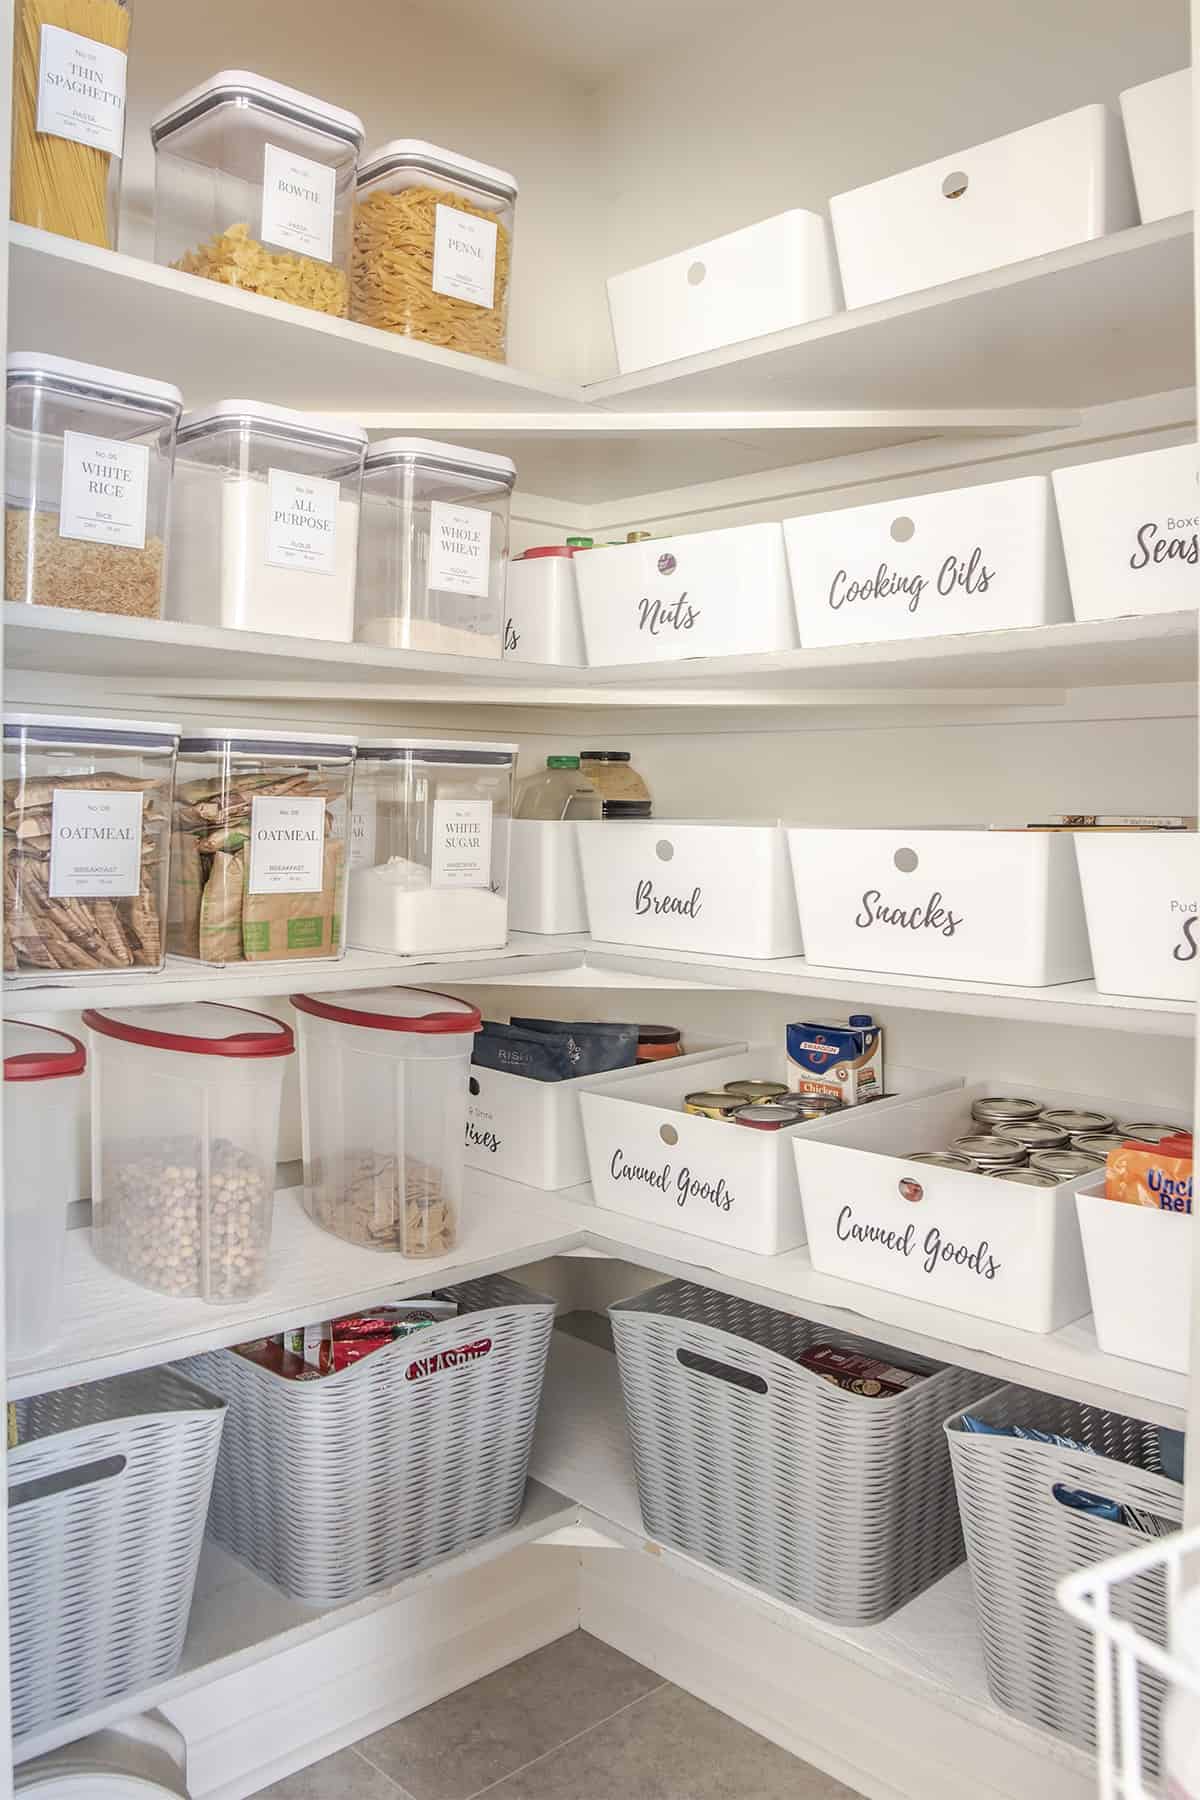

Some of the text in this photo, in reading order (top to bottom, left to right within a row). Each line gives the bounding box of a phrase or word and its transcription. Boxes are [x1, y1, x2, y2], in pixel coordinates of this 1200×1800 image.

[71, 62, 104, 83] THIN
[82, 461, 132, 482] WHITE
[89, 480, 124, 498] RICE
[294, 499, 316, 513] ALL
[274, 510, 331, 532] PURPOSE
[441, 525, 481, 543] WHOLE
[441, 540, 481, 557] WHEAT
[828, 547, 996, 613] Cooking Oils
[638, 591, 701, 636] Nuts
[59, 826, 135, 841] OATMEAL
[257, 828, 320, 842] OATMEAL
[445, 823, 480, 834] WHITE
[444, 837, 480, 849] SUGAR
[634, 879, 703, 920] Bread
[855, 889, 964, 937] Snacks
[803, 1082, 840, 1098] Chicken
[610, 1148, 736, 1212] Canned Goods
[836, 1205, 1001, 1280] Canned Goods
